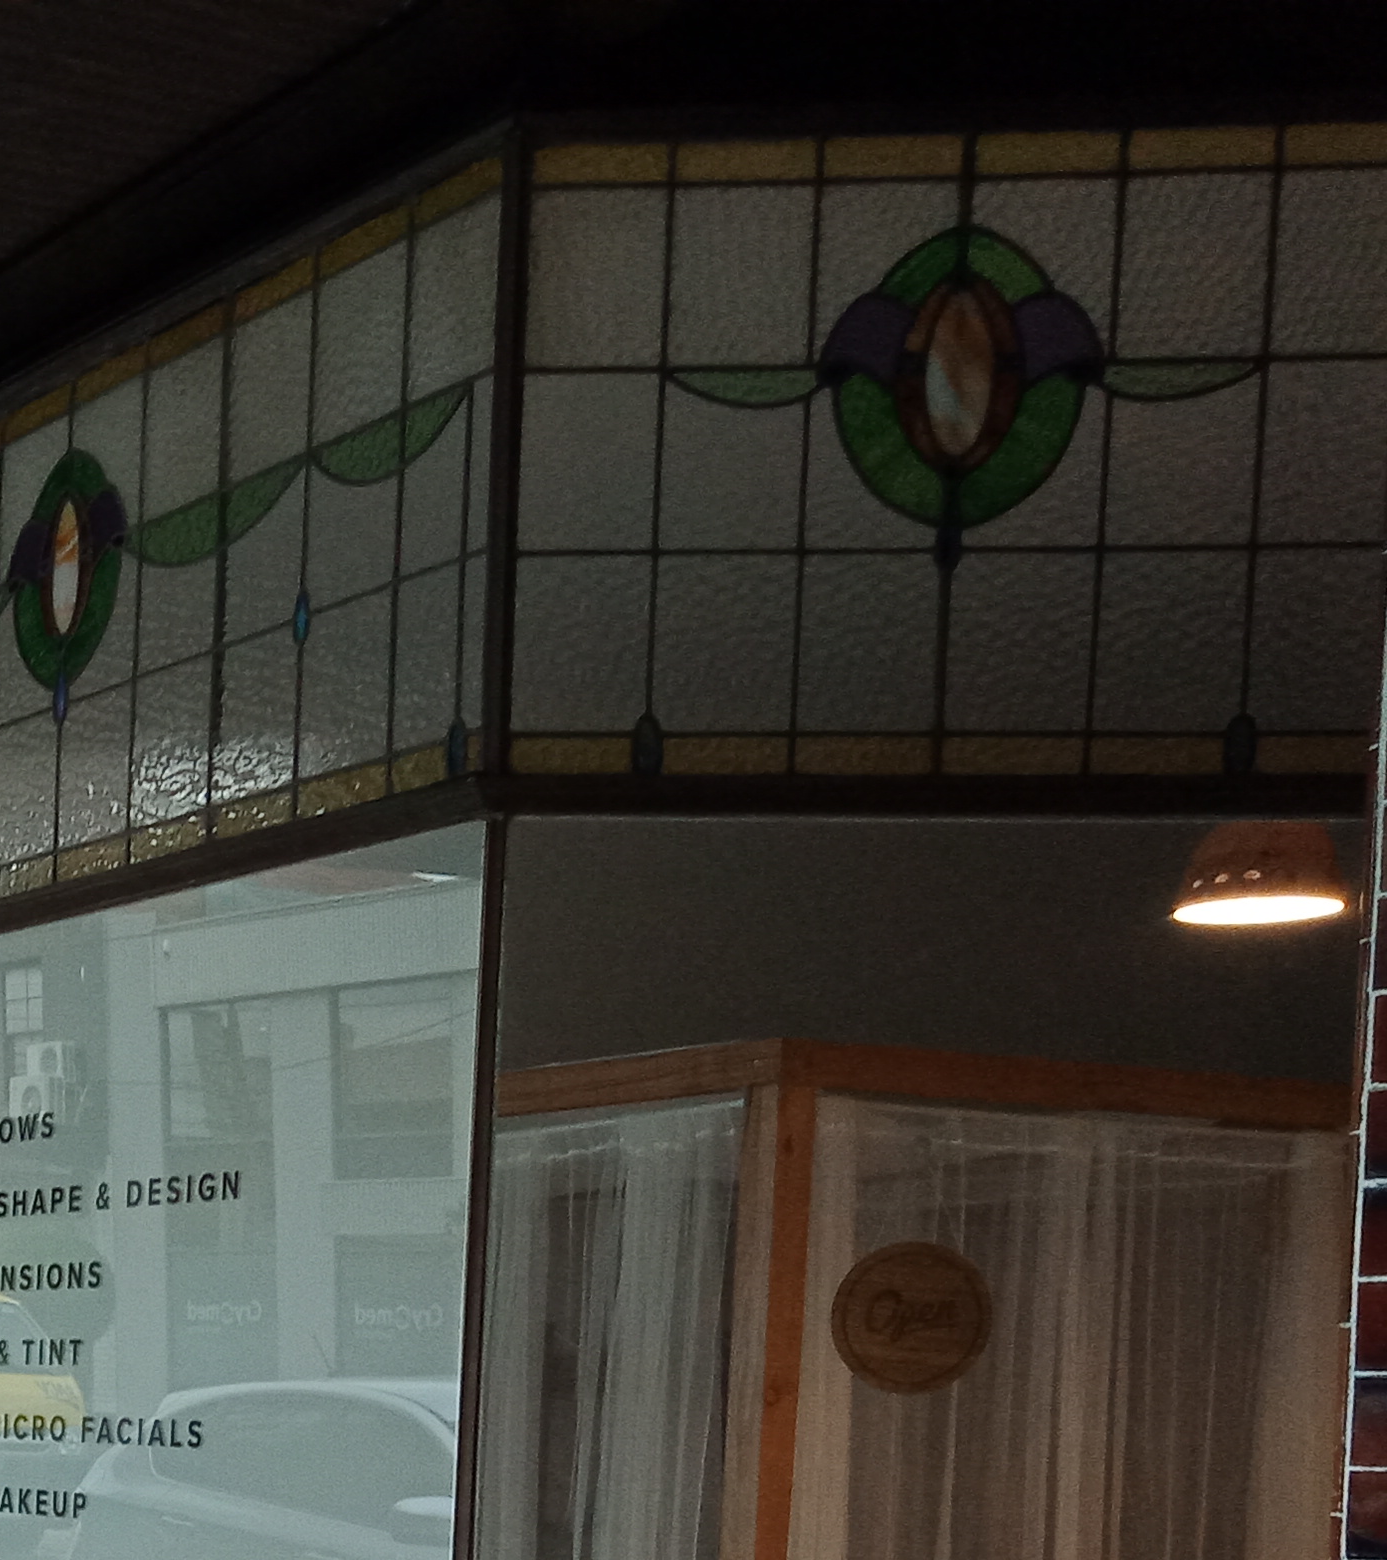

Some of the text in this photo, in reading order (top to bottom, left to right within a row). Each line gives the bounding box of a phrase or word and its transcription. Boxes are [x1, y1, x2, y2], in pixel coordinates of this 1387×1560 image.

[95, 1183, 110, 1210] &
[126, 1170, 242, 1208] DESIGN
[22, 1339, 83, 1366] TINT
[81, 1416, 204, 1448] FACIALS
